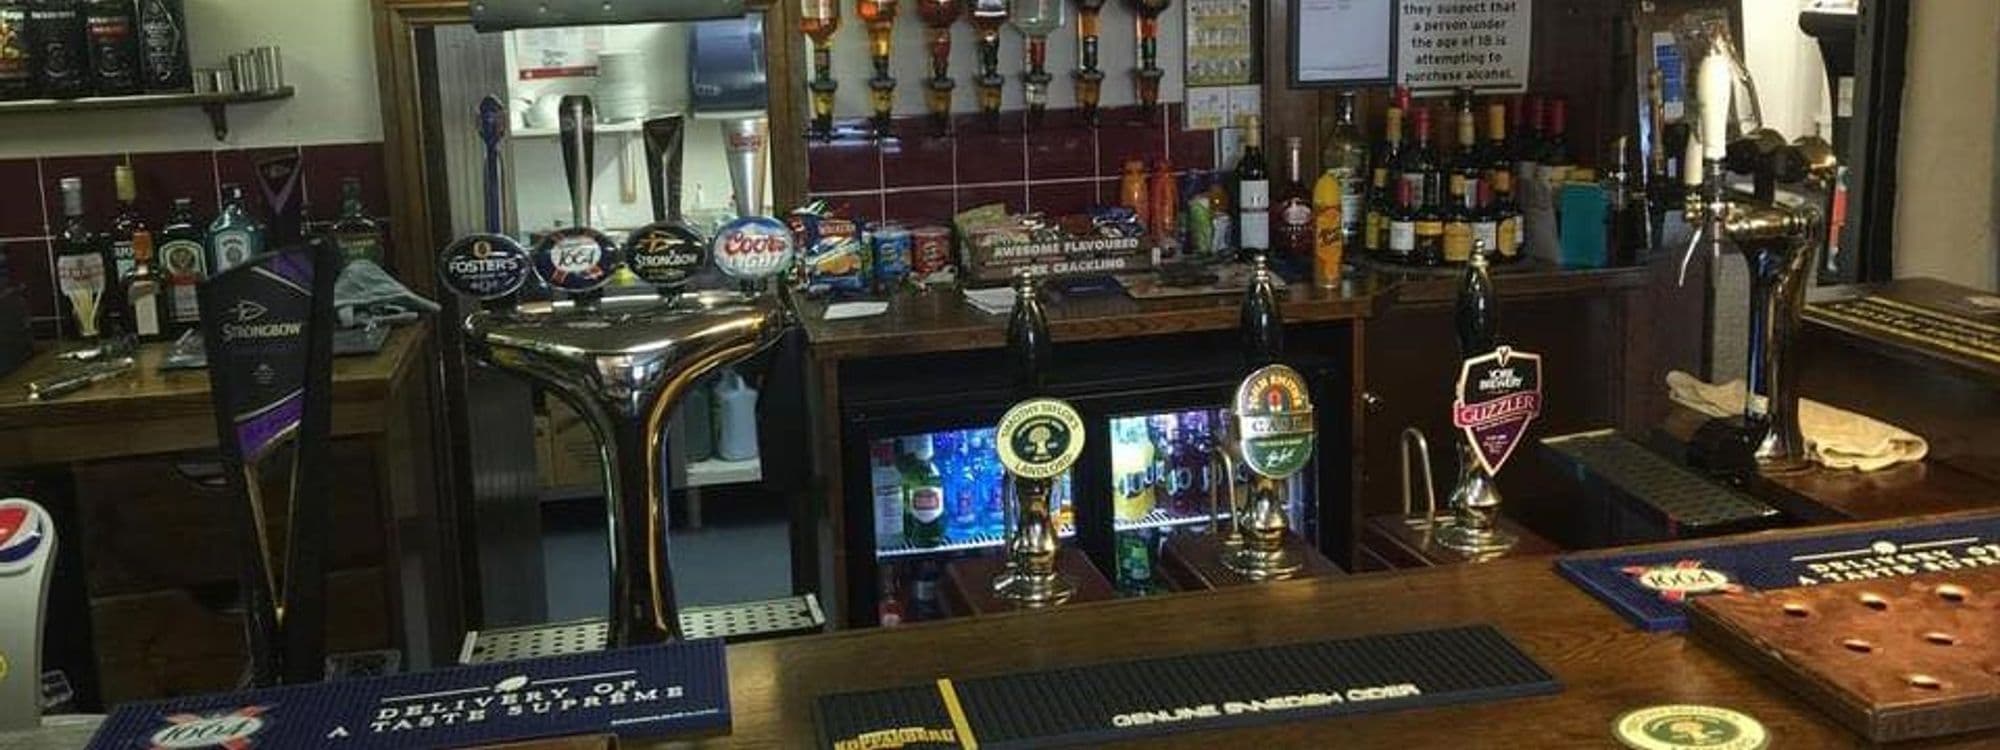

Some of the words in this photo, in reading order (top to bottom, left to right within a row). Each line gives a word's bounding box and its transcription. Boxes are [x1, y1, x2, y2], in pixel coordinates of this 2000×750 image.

[1404, 2, 1432, 16] they
[1437, 3, 1486, 15] suspect
[1490, 1, 1516, 13] that
[1413, 22, 1421, 31] a
[1424, 20, 1467, 32] person
[1470, 18, 1505, 30] under
[1411, 36, 1432, 48] the
[1436, 37, 1457, 48] age
[1461, 34, 1474, 47] of
[1478, 34, 1492, 46] 18
[1495, 35, 1506, 46] is
[1415, 51, 1484, 65] attempting
[1488, 51, 1503, 62] to
[1404, 69, 1461, 84] purchase
[994, 241, 1061, 257] AWESOME
[1064, 236, 1139, 253] FLAVOURED
[1053, 257, 1126, 273] CRACKLING
[1460, 395, 1535, 422] GUZZLER
[1014, 452, 1072, 476] LANDLORD
[1806, 549, 1954, 574] DELIVERY
[1821, 562, 1917, 582] TASTE
[376, 686, 569, 720] DELIVERY
[593, 679, 638, 696] OF
[1111, 702, 1222, 728] GENUINE
[1223, 691, 1344, 714] SWEDISH
[1346, 682, 1421, 701] CIDER
[325, 726, 351, 739] A
[369, 708, 487, 733] TASTE
[507, 685, 684, 716] SUPRÊME
